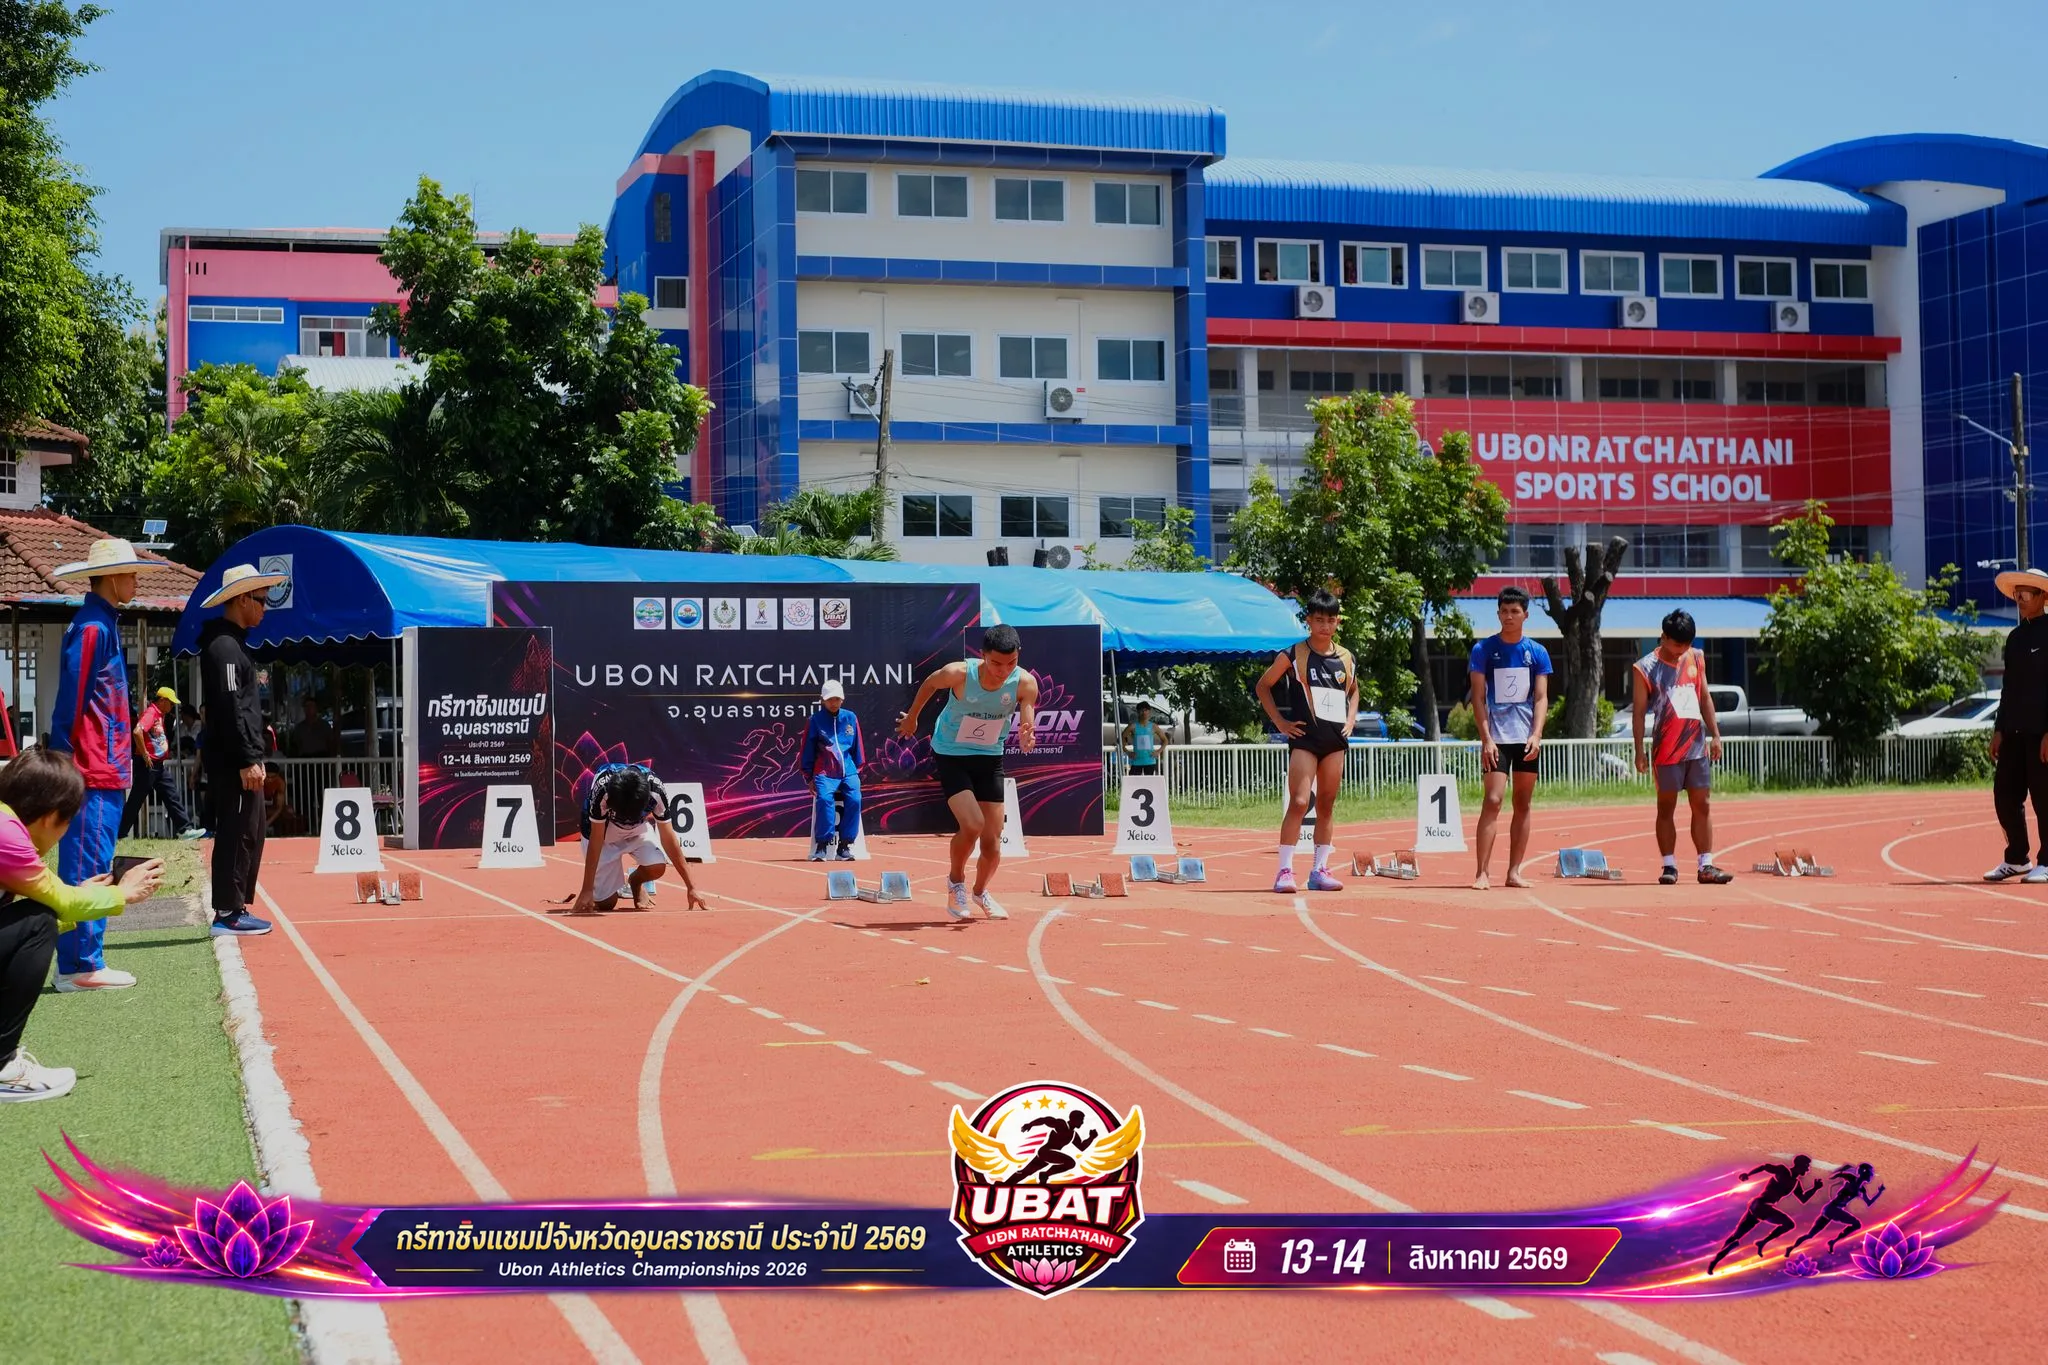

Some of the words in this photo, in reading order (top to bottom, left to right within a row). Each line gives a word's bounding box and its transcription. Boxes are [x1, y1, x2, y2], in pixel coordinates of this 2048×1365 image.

[1478, 433, 1793, 465] UBONRATCHATHANI
[1515, 472, 1636, 500] SPORTS
[1652, 473, 1771, 501] SCHOOL
[575, 664, 678, 687] UBON
[696, 663, 912, 686] RATCHATHANI
[1504, 675, 1518, 697] 3
[427, 693, 547, 717] กรีฑาชิงแชมป์
[1321, 691, 1334, 712] 4
[972, 723, 986, 737] 6
[474, 754, 507, 765] สิงหาคม
[509, 753, 531, 764] 2569
[670, 794, 694, 833] 6
[1131, 789, 1155, 827] 3
[1430, 786, 1447, 824] 1
[334, 799, 361, 841] 8
[496, 798, 523, 838] 7
[1127, 830, 1156, 841] Nelco
[1425, 826, 1451, 838] Nelco
[331, 844, 363, 856] Nelco
[493, 842, 524, 853] Nelco
